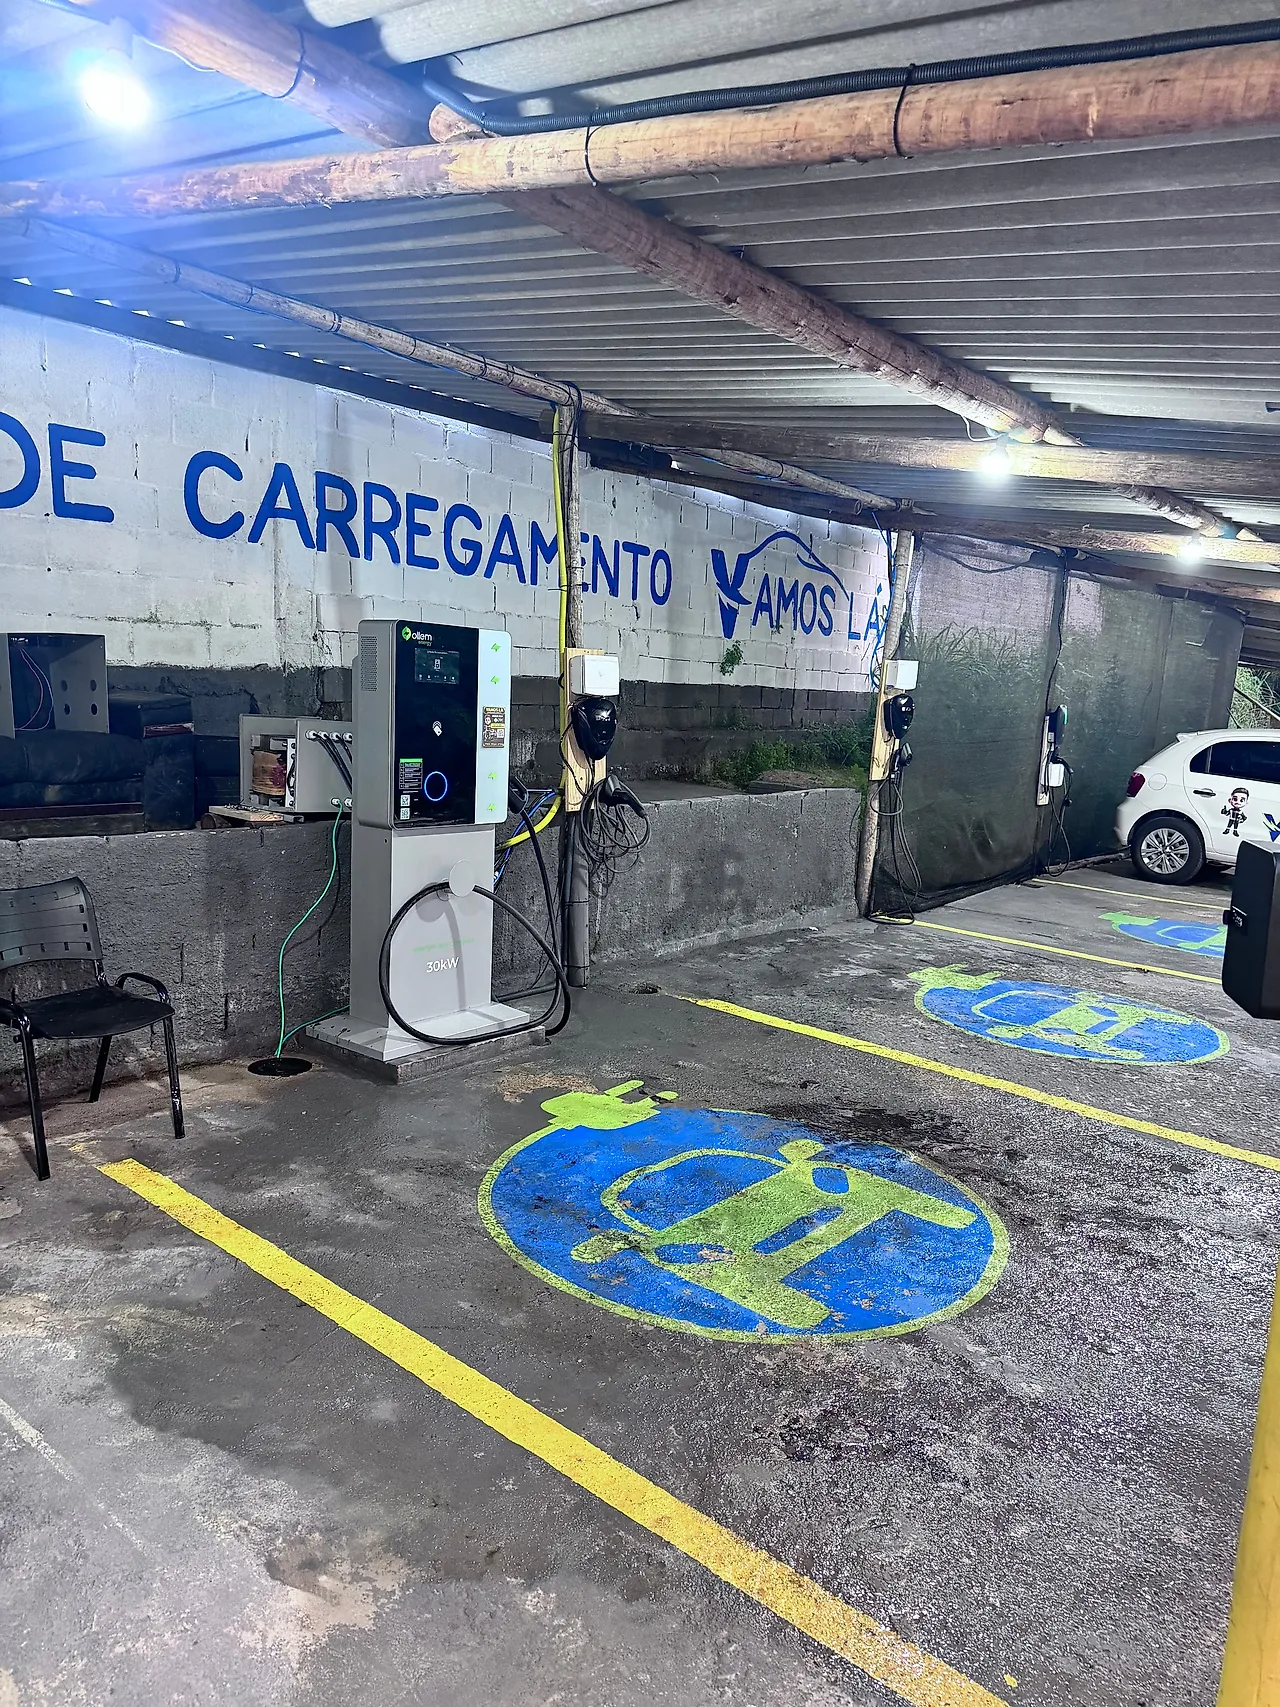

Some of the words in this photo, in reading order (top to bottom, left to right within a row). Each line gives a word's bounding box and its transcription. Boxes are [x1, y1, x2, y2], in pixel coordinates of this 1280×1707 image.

[0, 411, 114, 523] DE
[711, 549, 836, 640] VAMOS
[426, 957, 460, 973] 30kW
